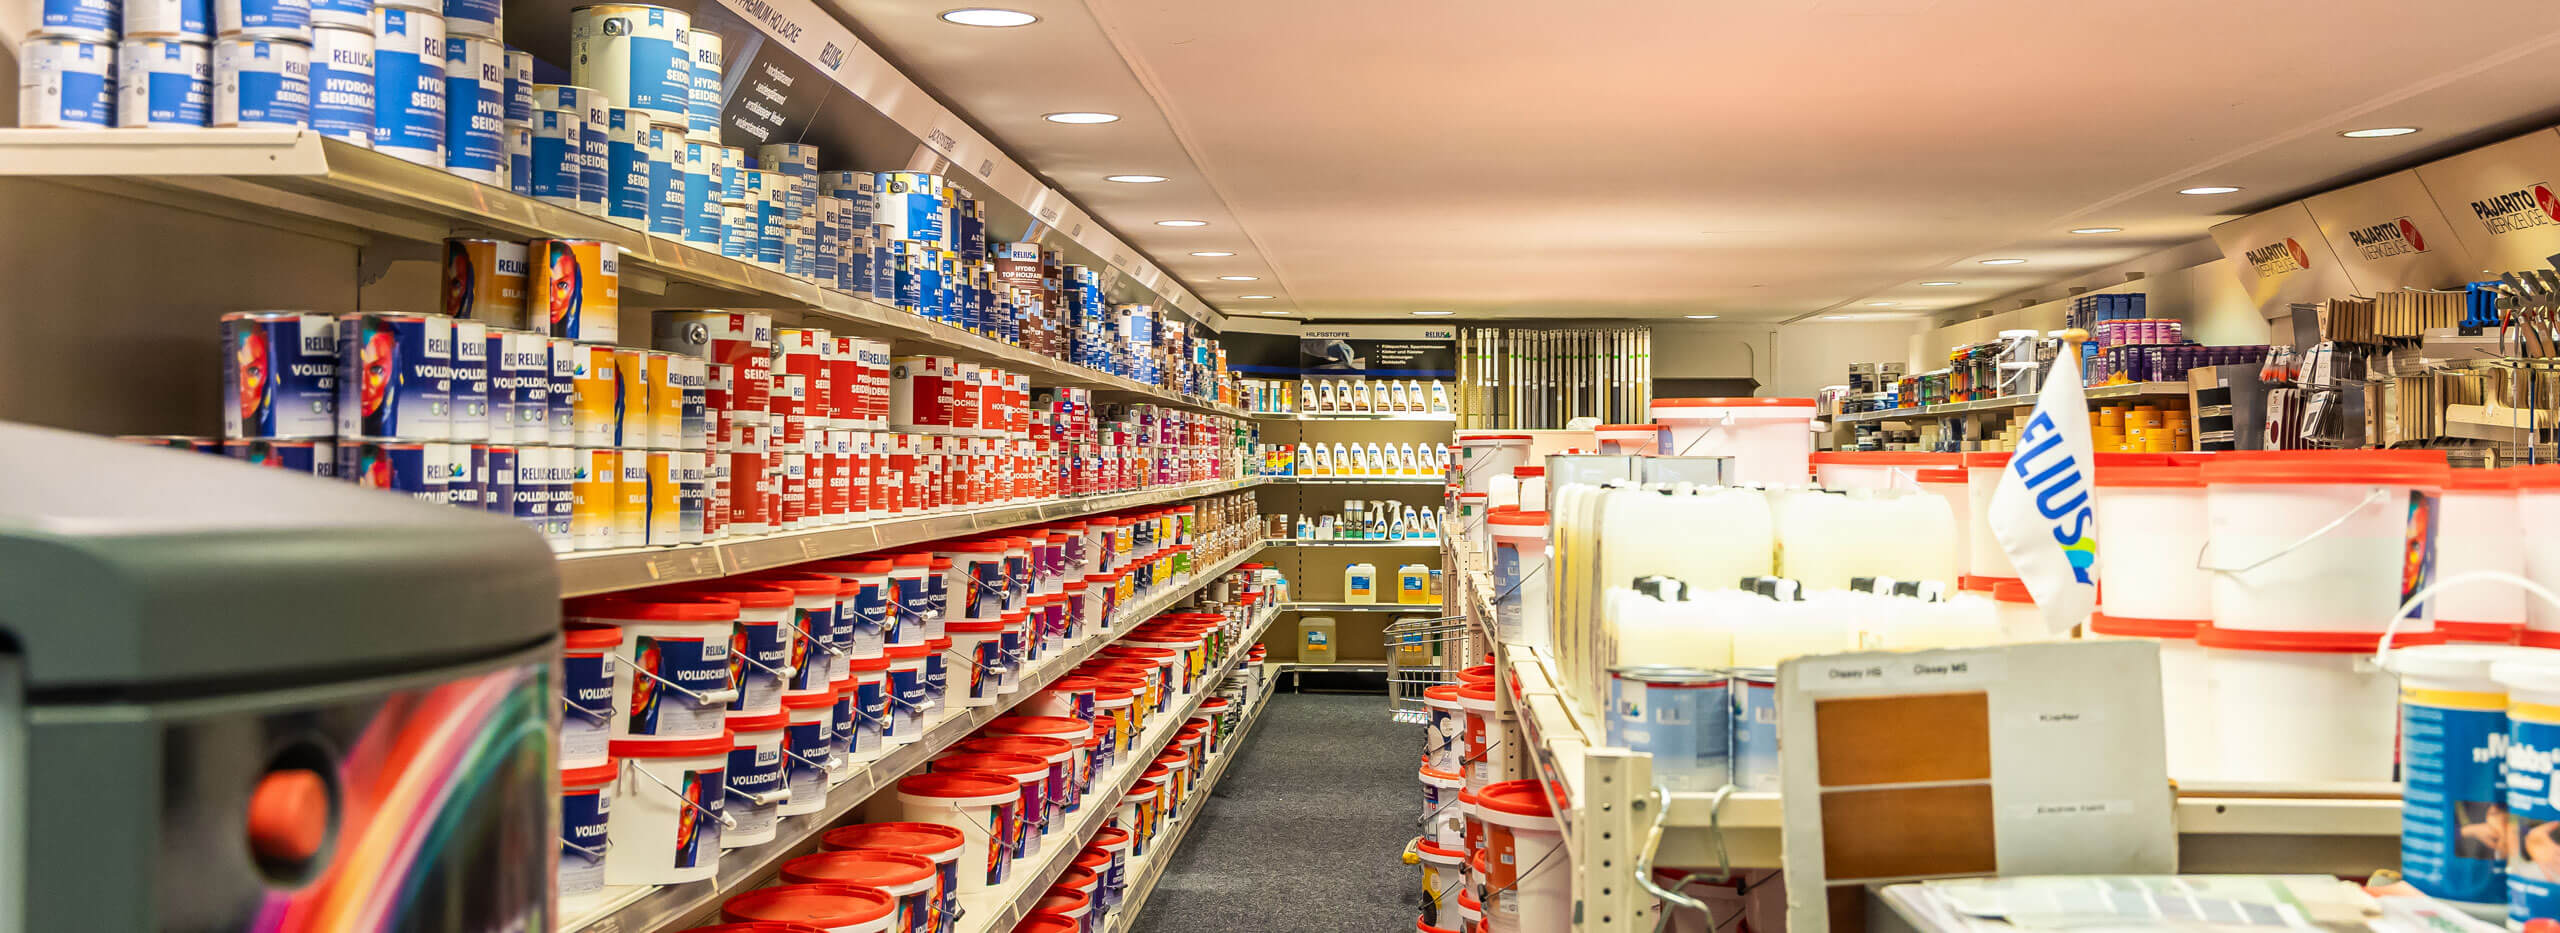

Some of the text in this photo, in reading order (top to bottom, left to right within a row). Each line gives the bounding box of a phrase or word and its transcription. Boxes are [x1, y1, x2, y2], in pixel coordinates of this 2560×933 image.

[333, 49, 368, 67] RELIUS
[2470, 190, 2536, 220] PAJARITO
[2482, 208, 2549, 237] WERKZEUGE
[2349, 222, 2400, 247] PAJARITO
[1013, 250, 1032, 260] RELIUS
[2246, 242, 2290, 266] PAJARITO
[2357, 239, 2412, 261] WERKZEUGE
[2013, 410, 2093, 547] ELIUS
[705, 644, 724, 656] RELIUS
[676, 668, 725, 682] VOLLDECKER
[758, 750, 777, 763] RELIUS
